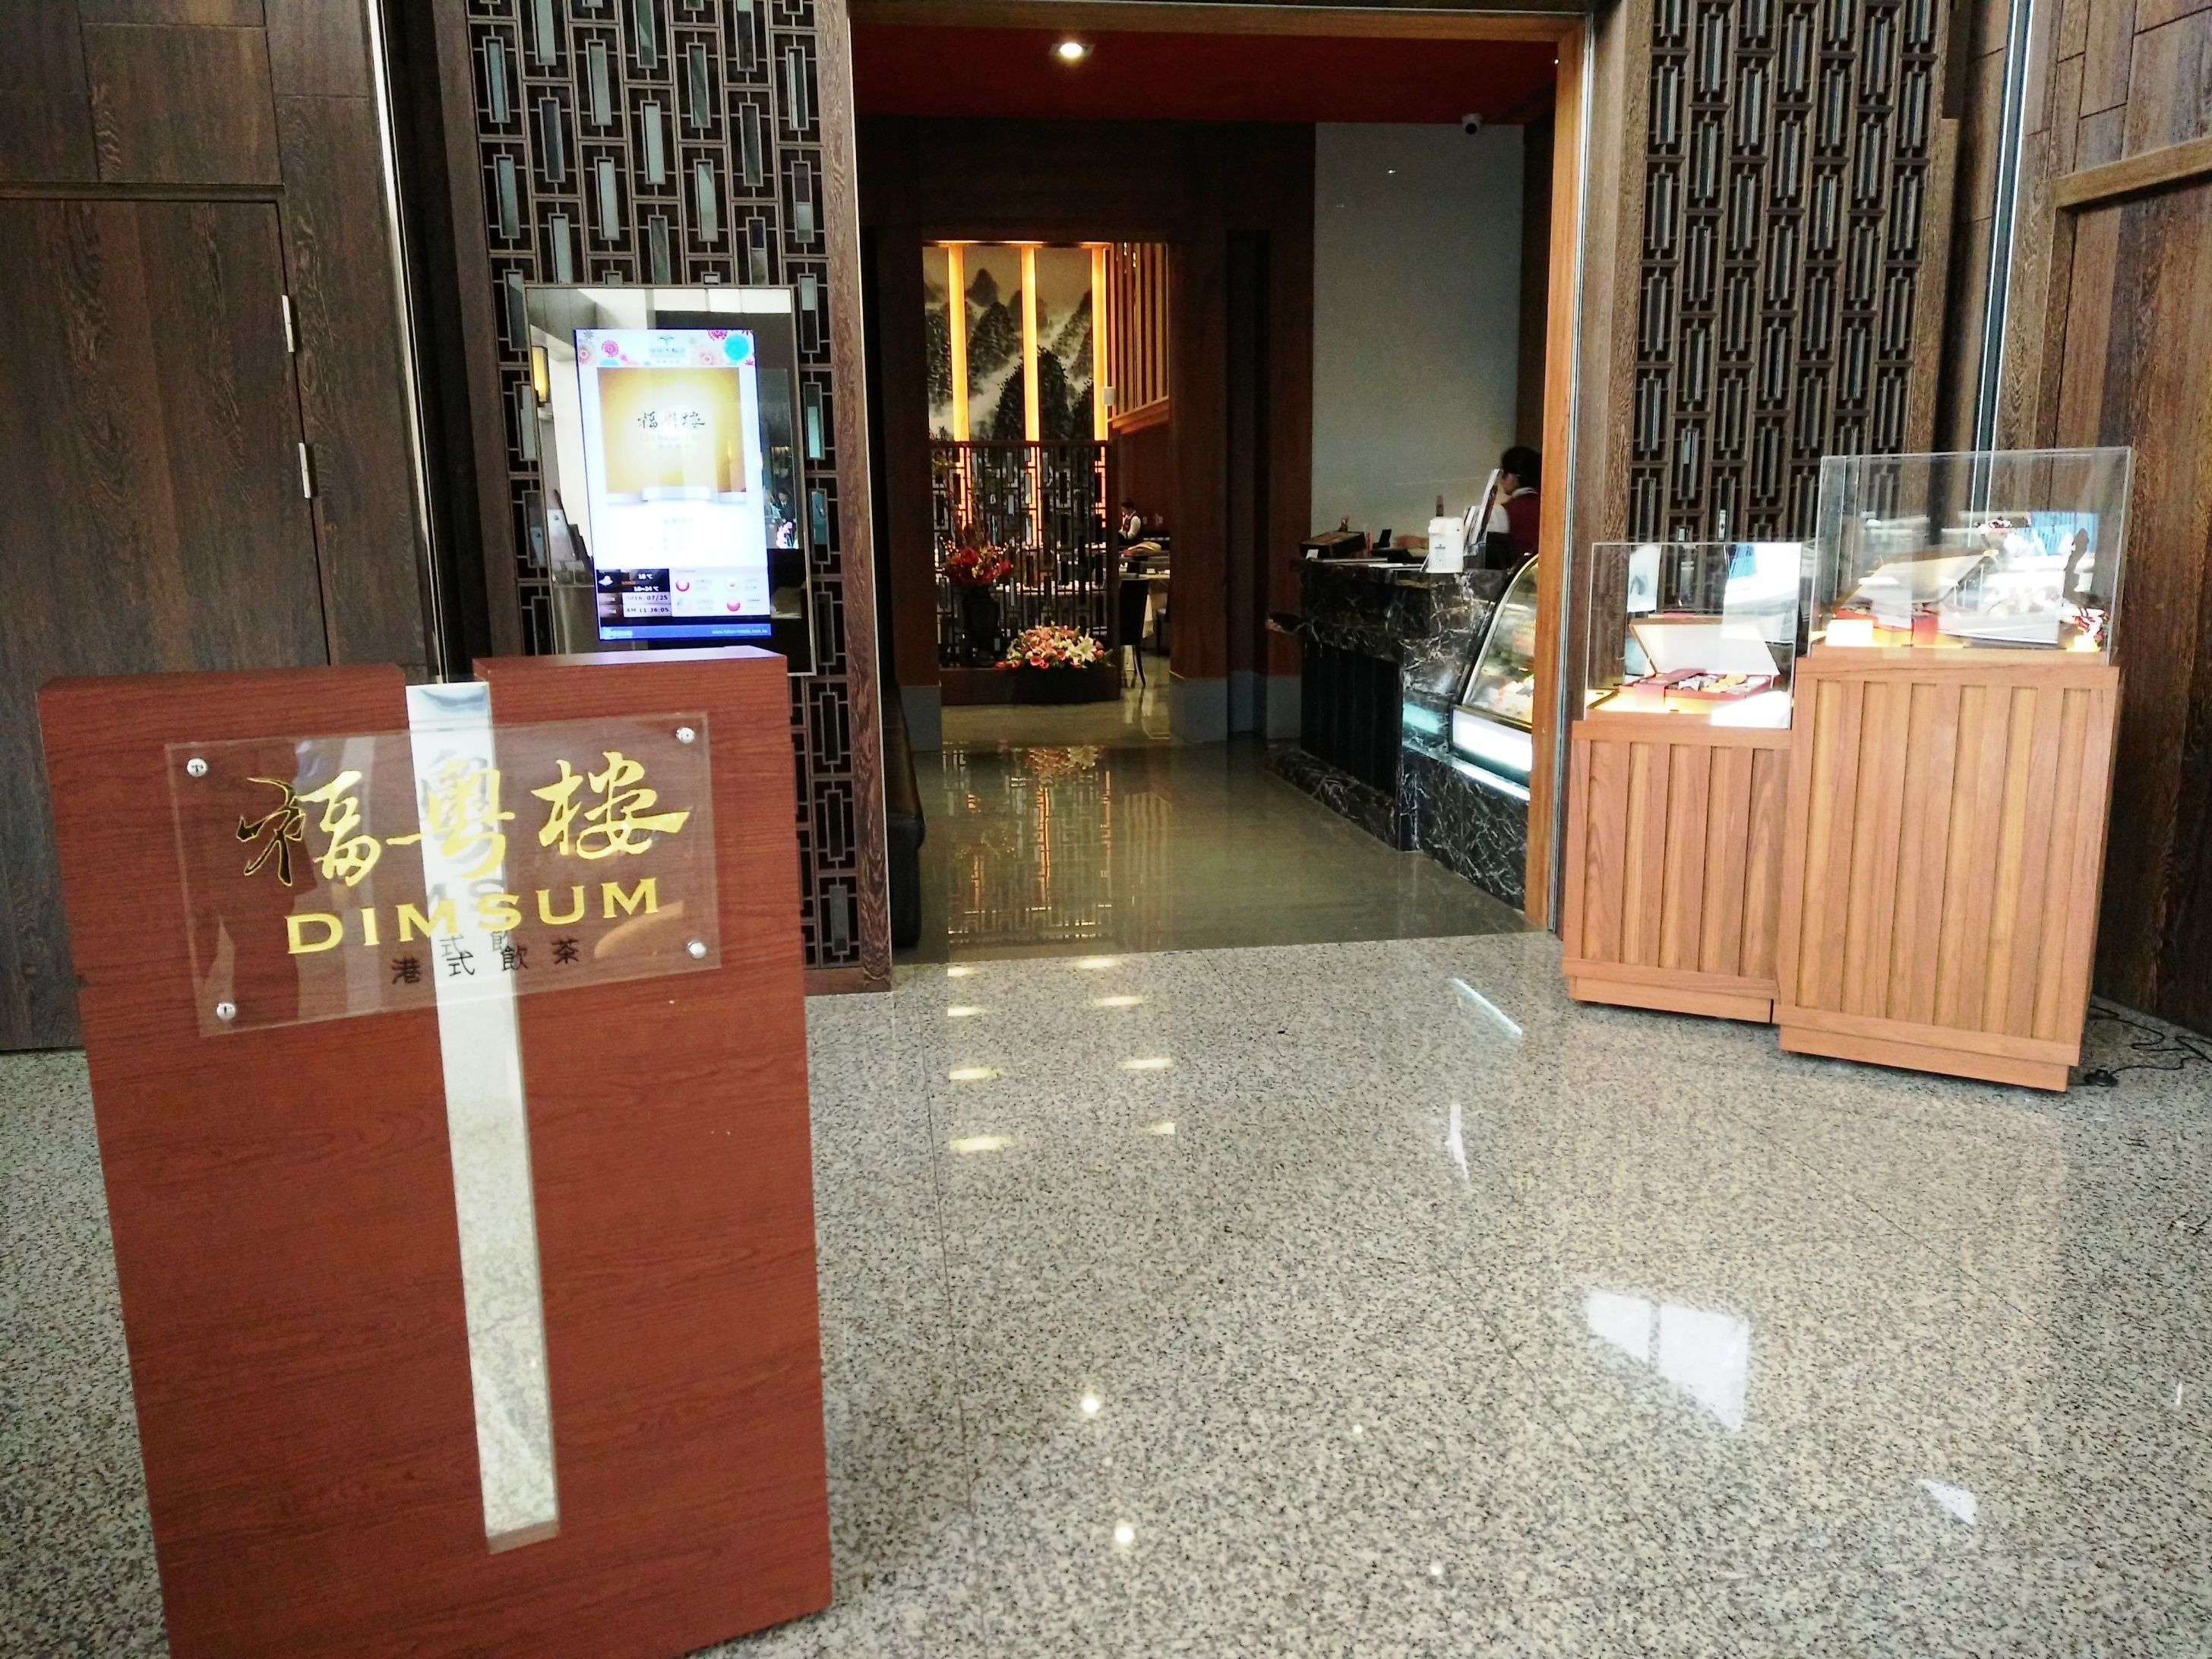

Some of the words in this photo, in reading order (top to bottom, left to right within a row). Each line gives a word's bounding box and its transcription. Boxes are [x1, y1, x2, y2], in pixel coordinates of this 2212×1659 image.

[286, 877, 660, 955] DIMSUM
[391, 938, 581, 985] 港式飲茶
